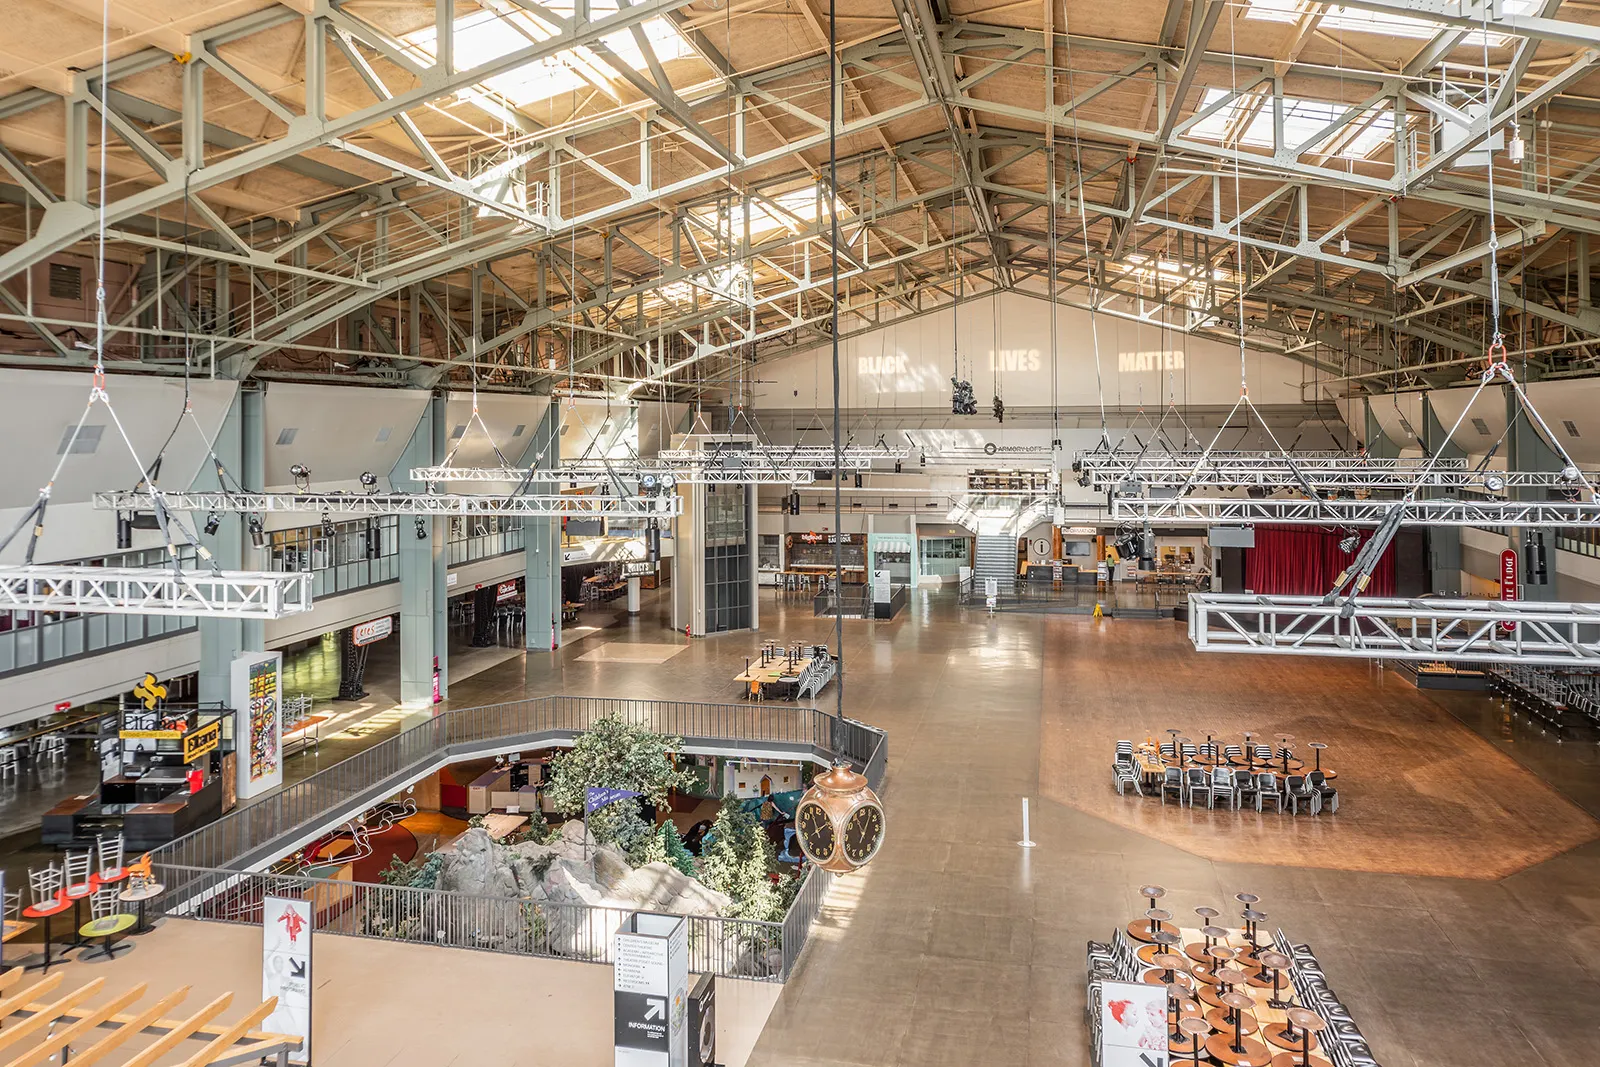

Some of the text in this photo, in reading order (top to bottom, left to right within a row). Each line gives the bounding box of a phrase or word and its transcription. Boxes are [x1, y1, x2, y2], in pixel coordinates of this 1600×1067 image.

[858, 349, 1186, 374] BLACK LIVES MATTER
[1504, 556, 1514, 585] FUDGE
[628, 1022, 665, 1032] INFORMATION
